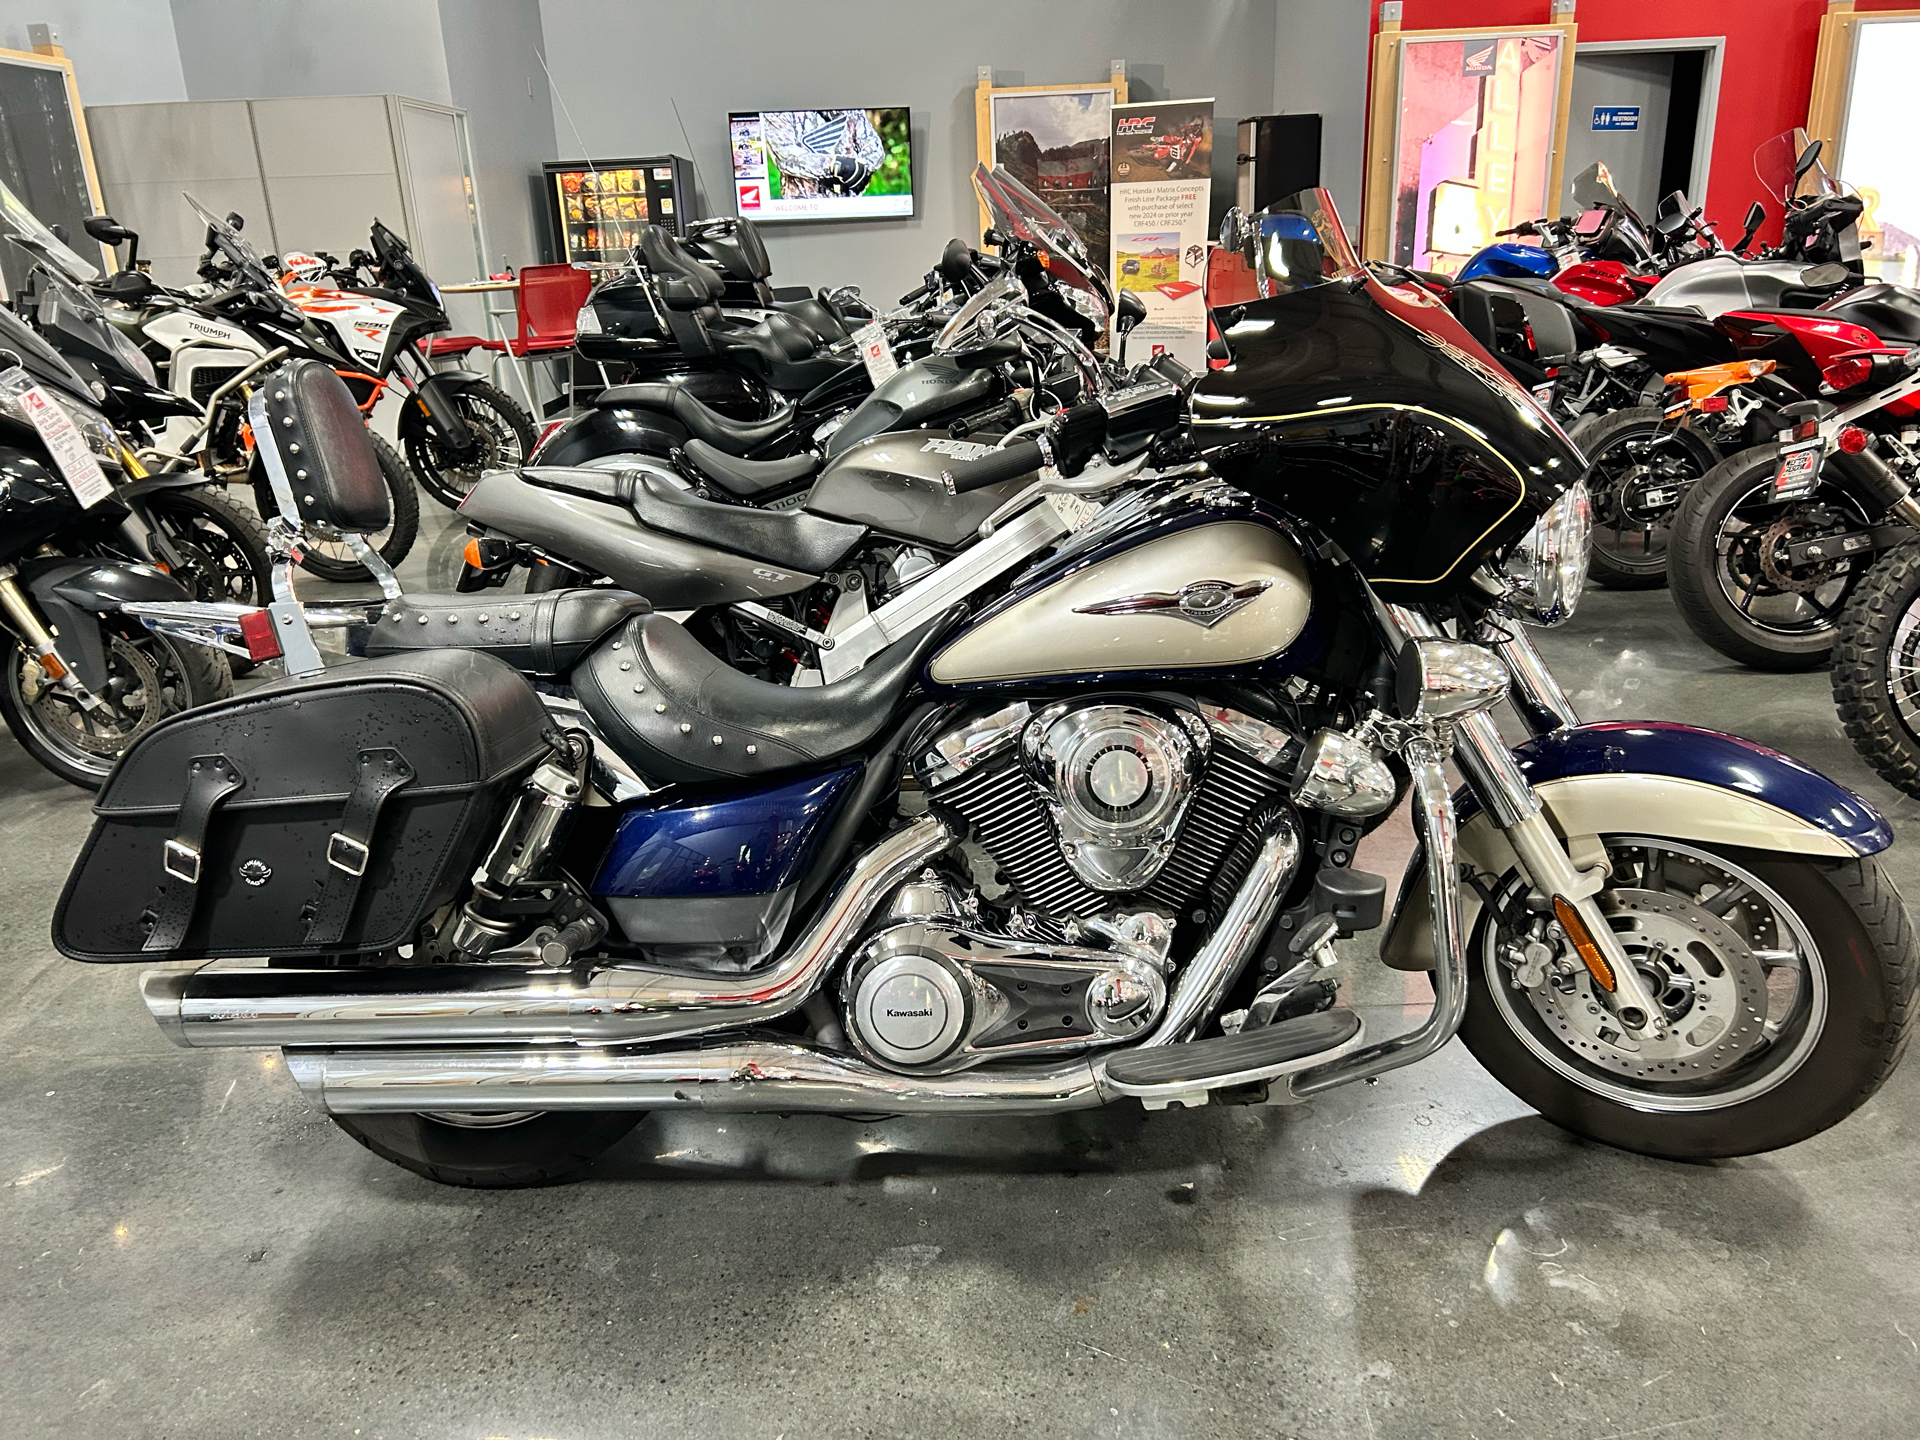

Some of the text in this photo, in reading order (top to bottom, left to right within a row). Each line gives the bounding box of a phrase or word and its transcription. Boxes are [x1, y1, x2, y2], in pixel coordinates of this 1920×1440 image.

[1117, 116, 1156, 132] HRC
[1487, 41, 1517, 235] ALLEY
[1132, 187, 1152, 195] Honda
[1176, 185, 1204, 193] Concepts
[1141, 203, 1168, 211] purchase
[1165, 211, 1179, 219] prior
[288, 255, 317, 268] KTM
[1588, 268, 1621, 281] SUZUKI
[188, 321, 231, 340] TRIUMPH
[354, 321, 390, 329] 1290
[772, 492, 808, 510] 1100
[752, 568, 793, 581] GT
[242, 859, 267, 872] VIKING
[245, 877, 266, 887] BAGS
[886, 1008, 933, 1017] Kawasaki
